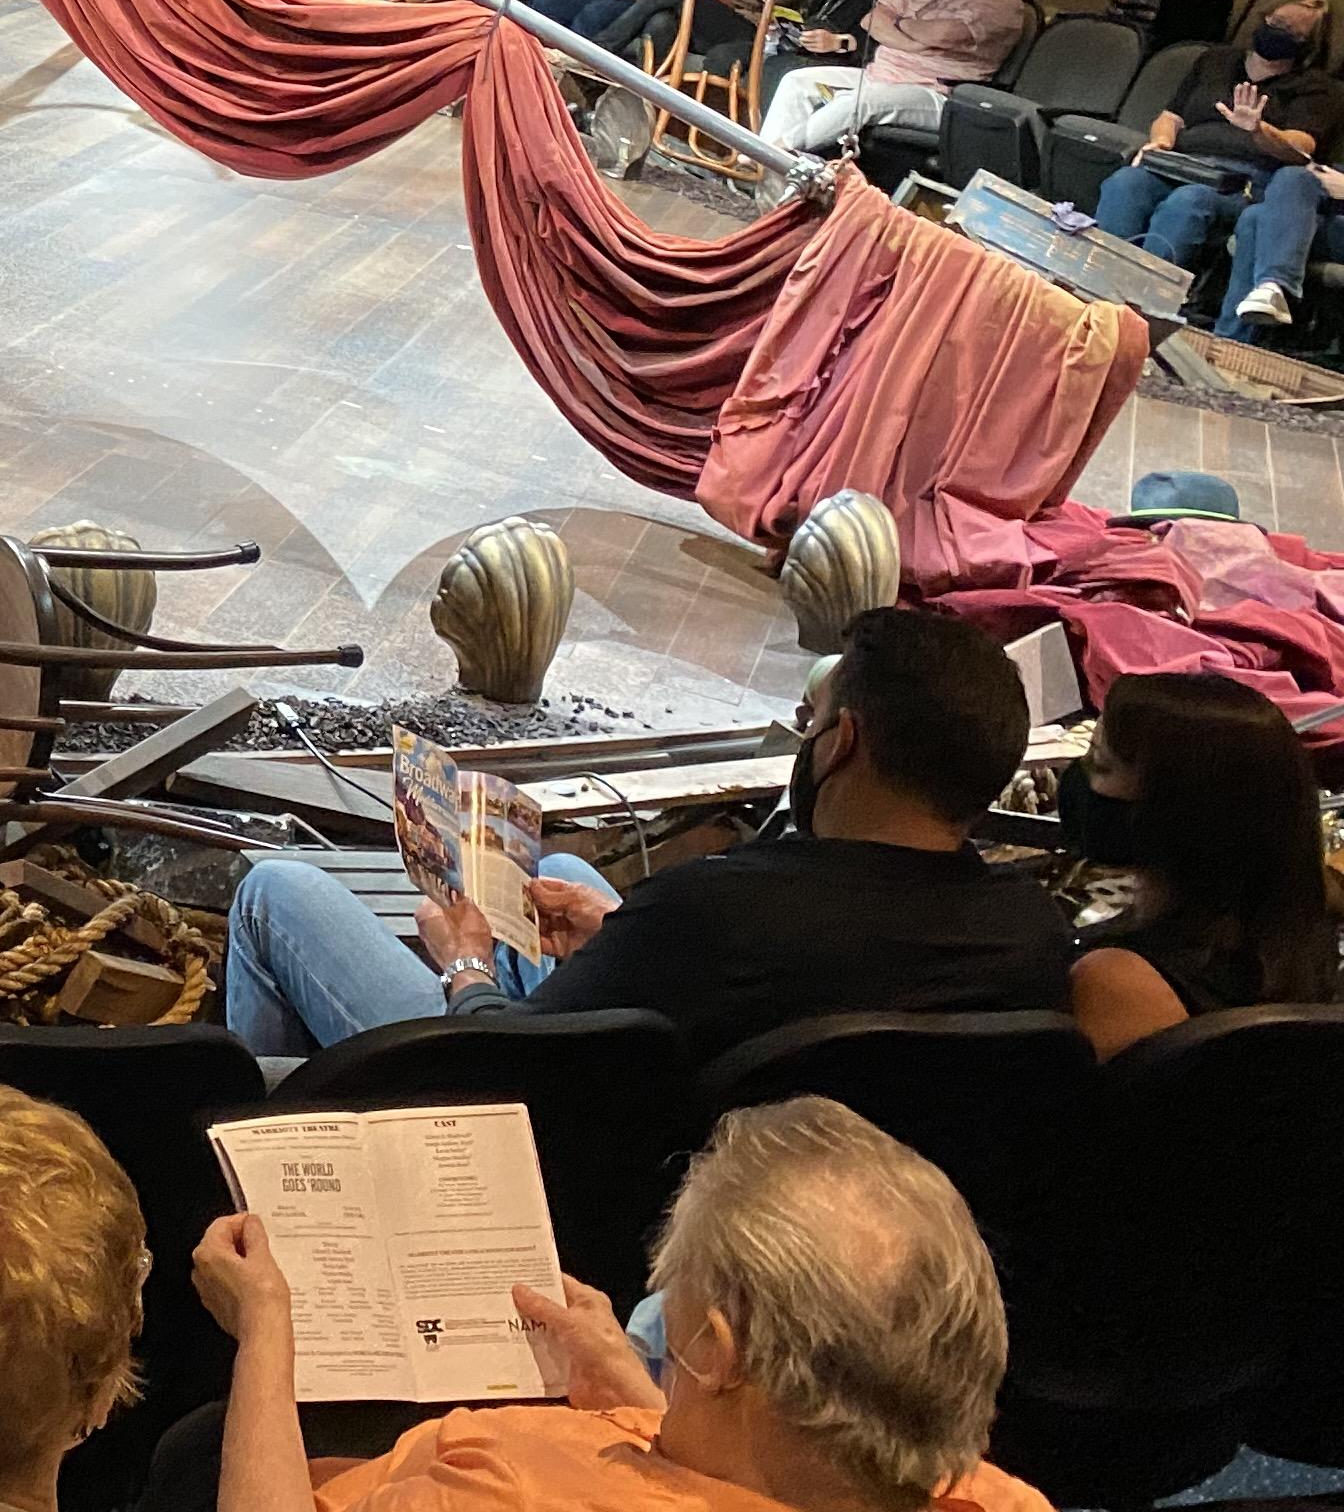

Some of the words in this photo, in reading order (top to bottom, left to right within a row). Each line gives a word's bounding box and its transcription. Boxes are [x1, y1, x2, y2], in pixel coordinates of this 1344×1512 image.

[281, 1162, 301, 1177] THE
[301, 1162, 334, 1177] WORLD
[282, 1178, 307, 1192] GOES
[508, 1318, 547, 1332] NAM
